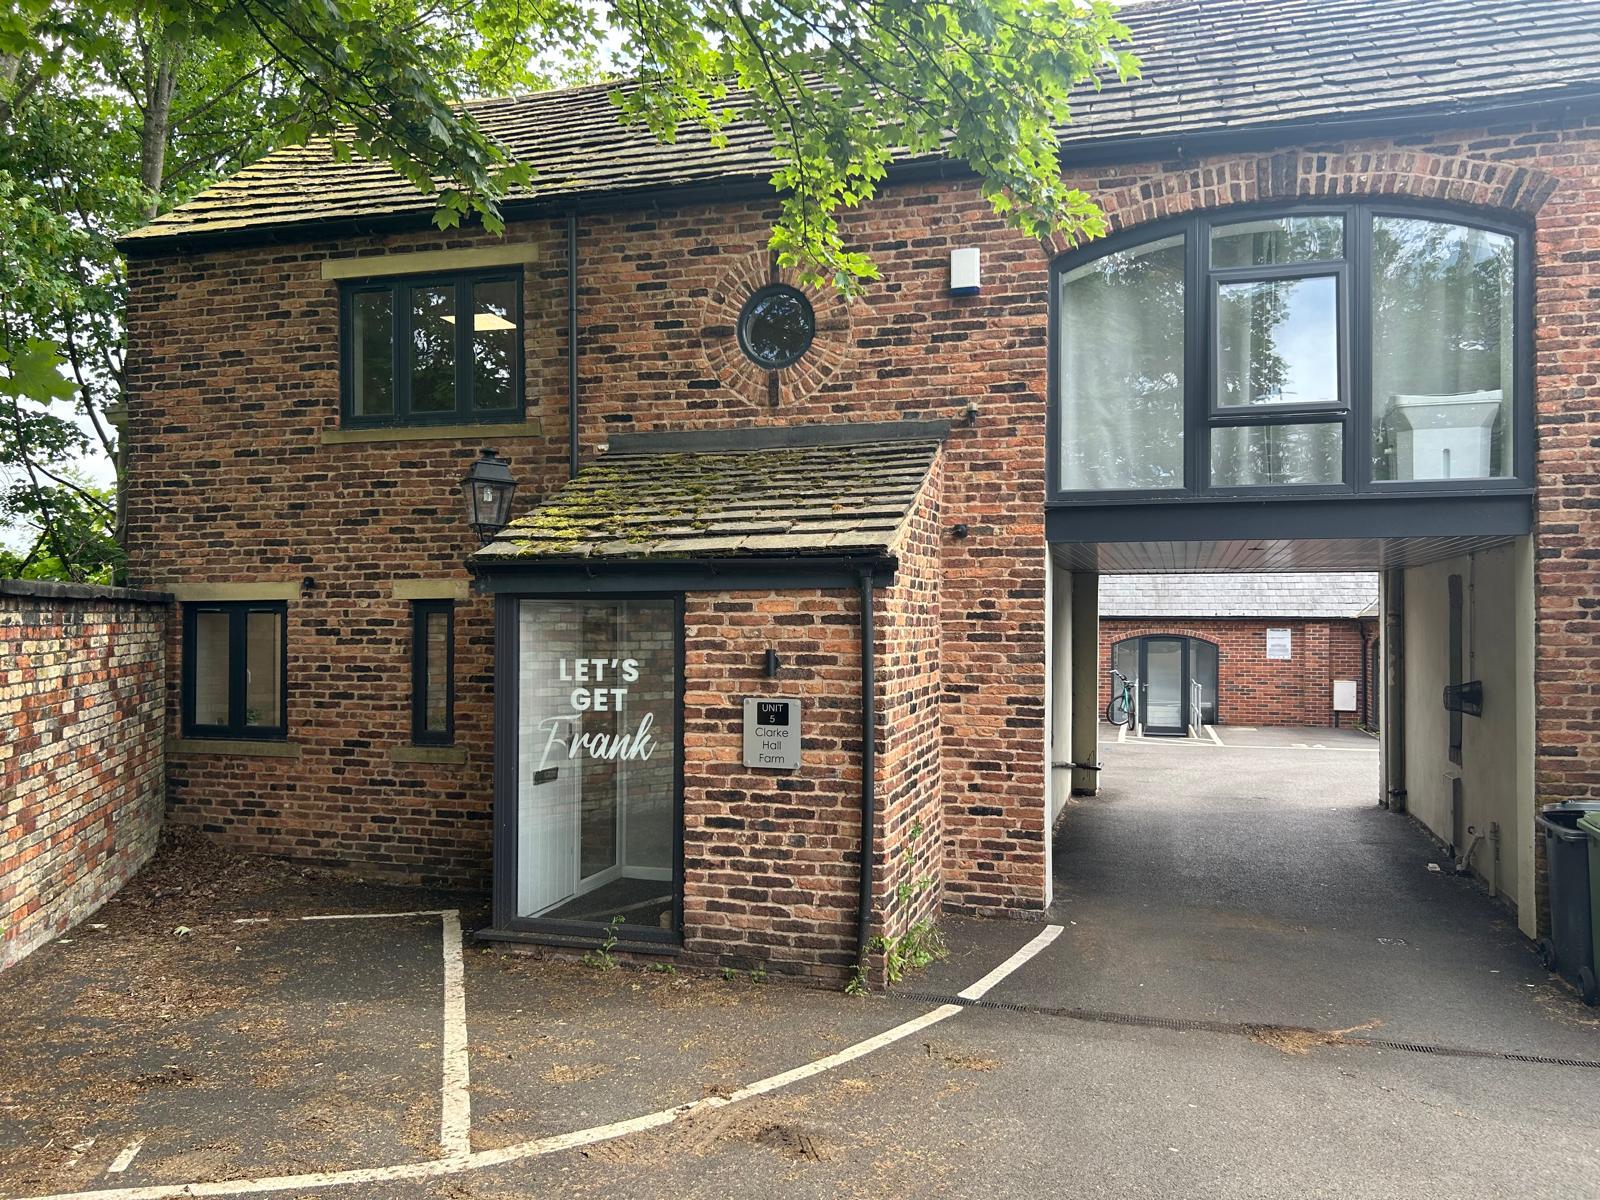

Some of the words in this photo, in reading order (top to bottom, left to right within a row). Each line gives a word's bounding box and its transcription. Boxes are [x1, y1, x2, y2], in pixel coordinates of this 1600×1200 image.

[559, 658, 639, 682] LET'S
[570, 687, 628, 711] GET
[761, 703, 784, 713] UNIT
[769, 714, 776, 724] 5
[755, 727, 789, 738] Clarke
[538, 712, 657, 772] Frank
[762, 740, 782, 750] Hall
[759, 753, 785, 763] Farm
